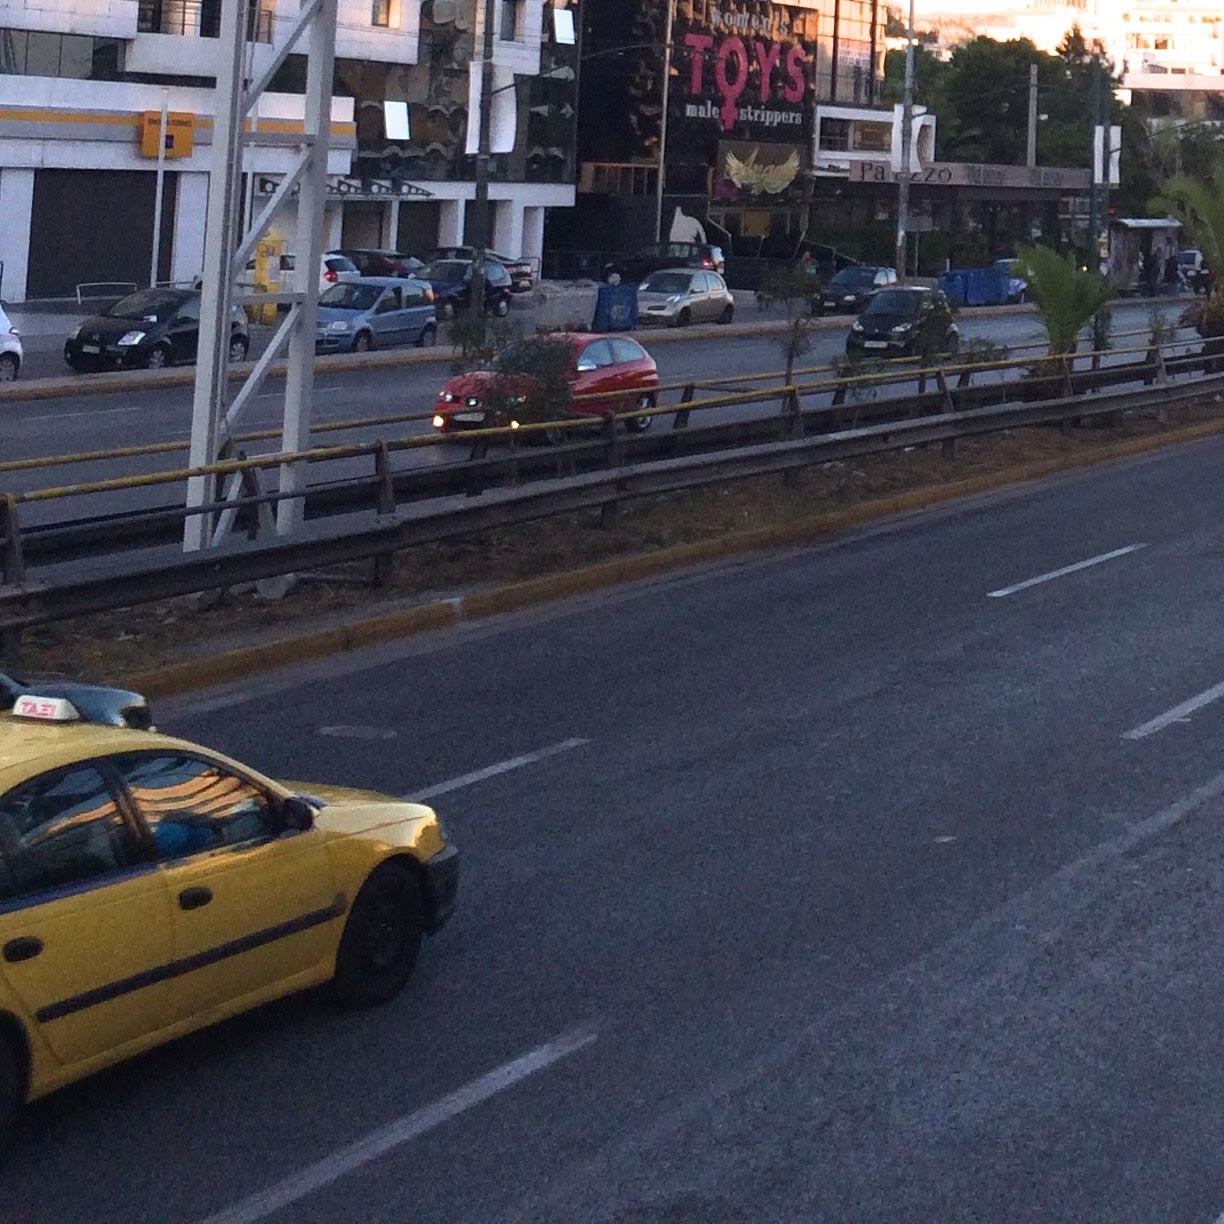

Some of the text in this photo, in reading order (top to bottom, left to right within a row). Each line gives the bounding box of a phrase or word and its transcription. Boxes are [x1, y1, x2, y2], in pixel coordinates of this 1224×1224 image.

[684, 33, 813, 129] TOYS
[685, 100, 803, 126] male strippers
